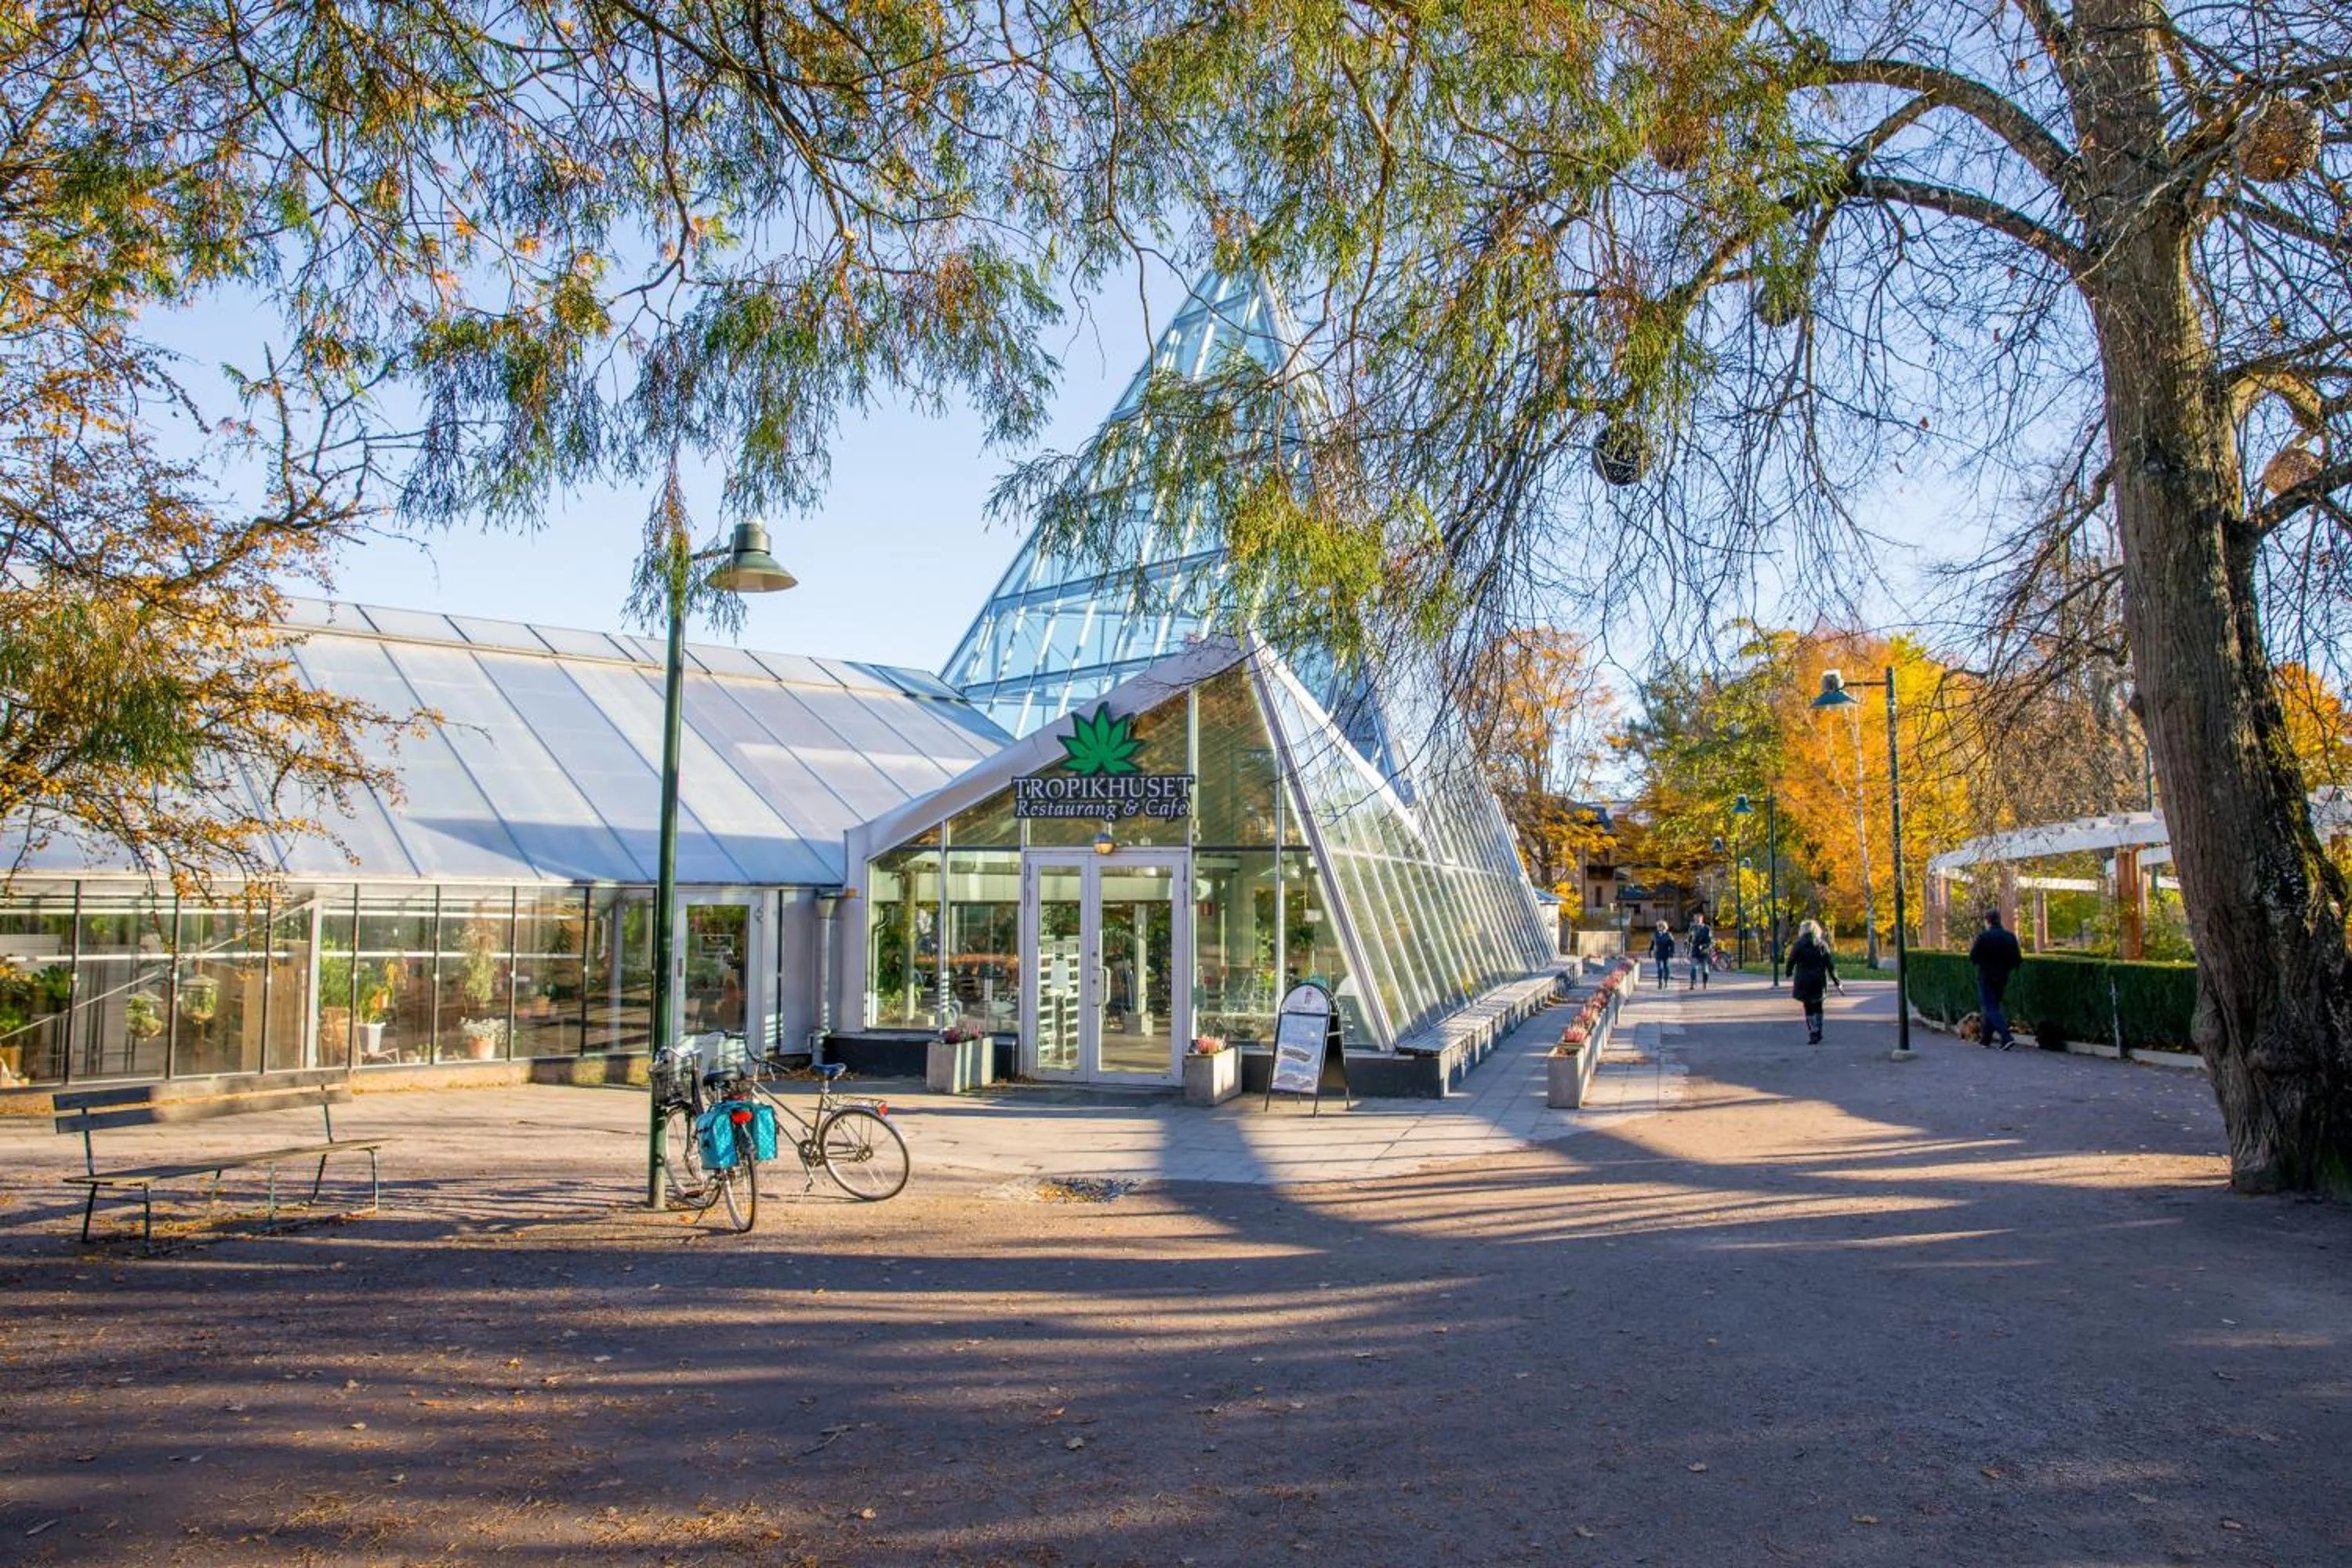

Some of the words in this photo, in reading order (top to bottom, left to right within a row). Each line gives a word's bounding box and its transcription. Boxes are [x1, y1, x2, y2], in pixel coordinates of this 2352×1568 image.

[1012, 777, 1193, 799] TROPIKHUSET
[1016, 800, 1116, 821] Restaurang
[1123, 800, 1139, 816] &
